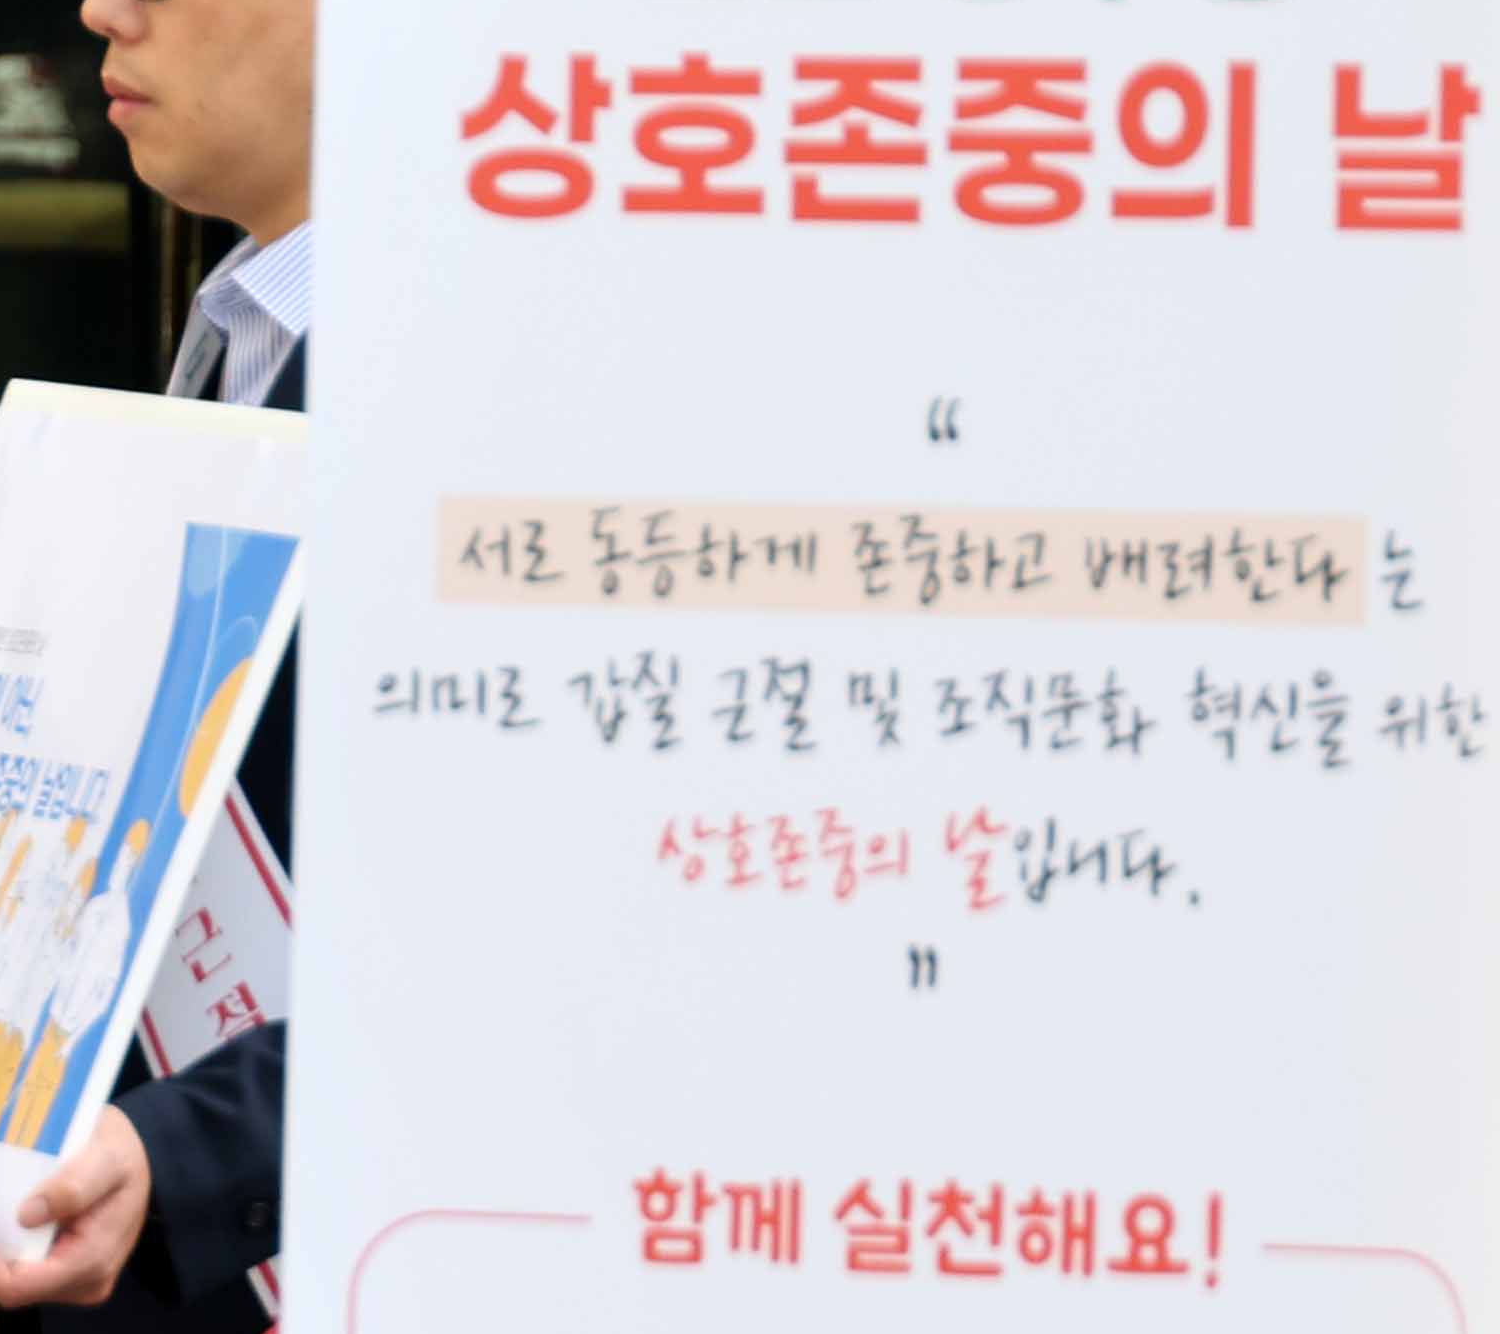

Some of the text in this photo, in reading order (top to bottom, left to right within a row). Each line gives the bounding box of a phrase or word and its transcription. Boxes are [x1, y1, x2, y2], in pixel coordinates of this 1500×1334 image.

[459, 51, 1482, 231] 상호존중의 날
[459, 507, 1423, 611] 서로 동등하게 존중하고 배려한다 는
[374, 650, 1489, 769] 의미로 갑질 근절 및 조직문화 혁신을 위한
[658, 805, 1202, 910] 상호존중의 날입니다.
[633, 1167, 1224, 1288] 함께 실천해요!
